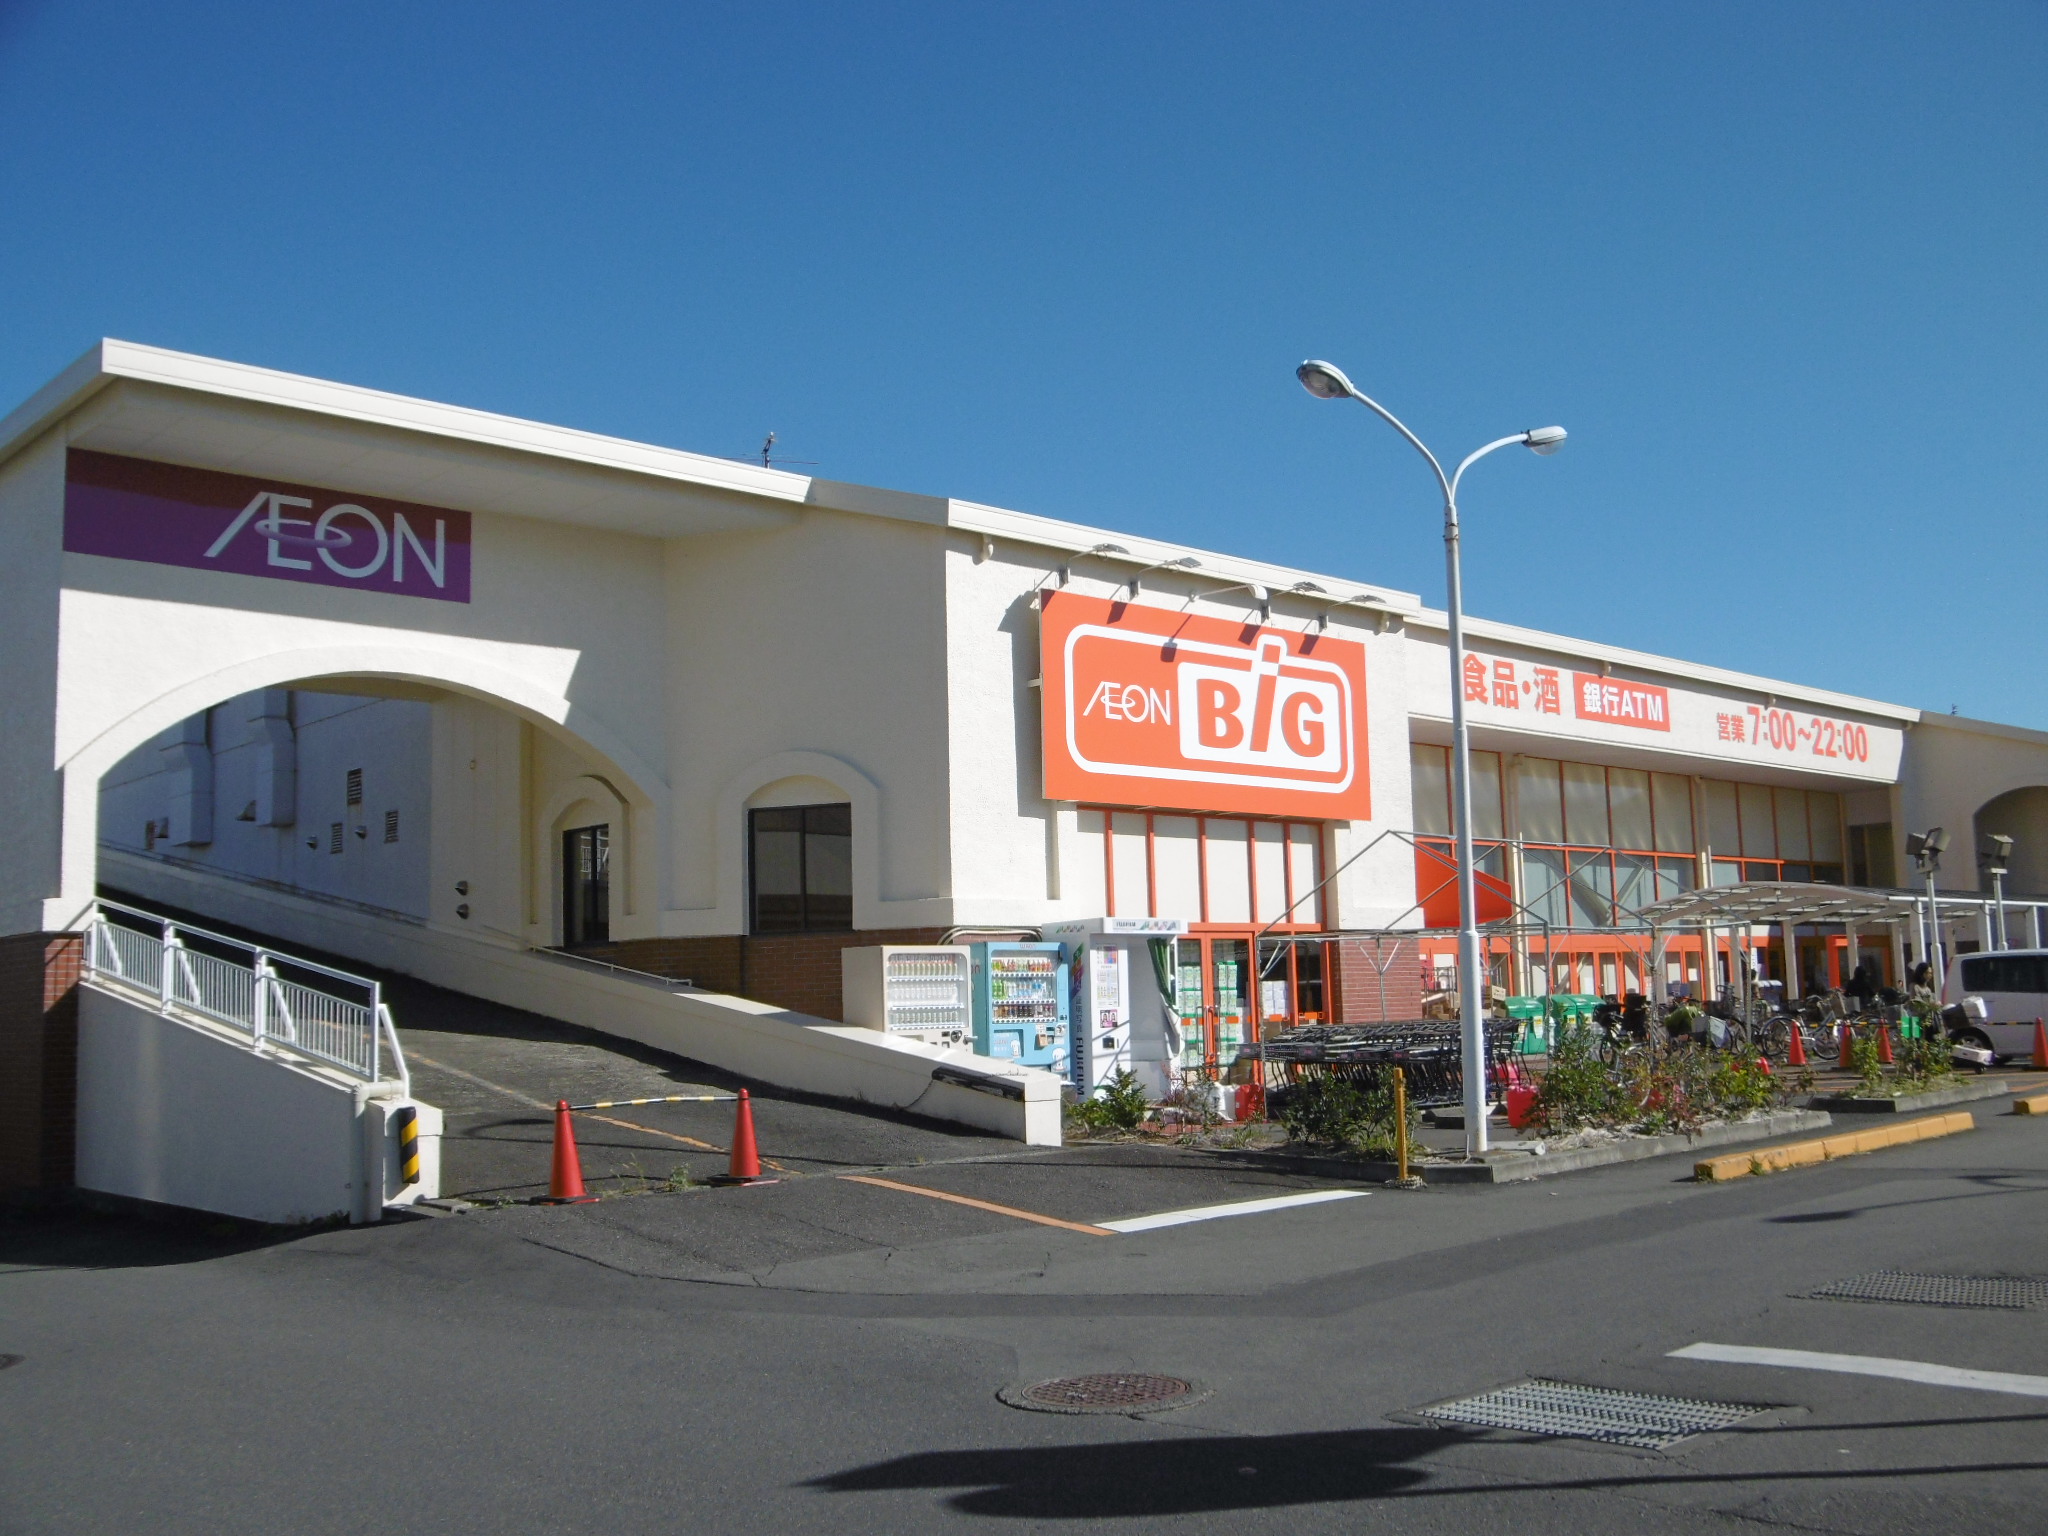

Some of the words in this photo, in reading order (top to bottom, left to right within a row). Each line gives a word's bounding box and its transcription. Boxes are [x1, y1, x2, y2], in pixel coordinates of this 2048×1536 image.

[1197, 644, 1326, 758] BIG
[1582, 681, 1664, 723] 銀行ATM
[1716, 712, 1745, 743] 営業
[1075, 1037, 1086, 1096] FUJIFILM
